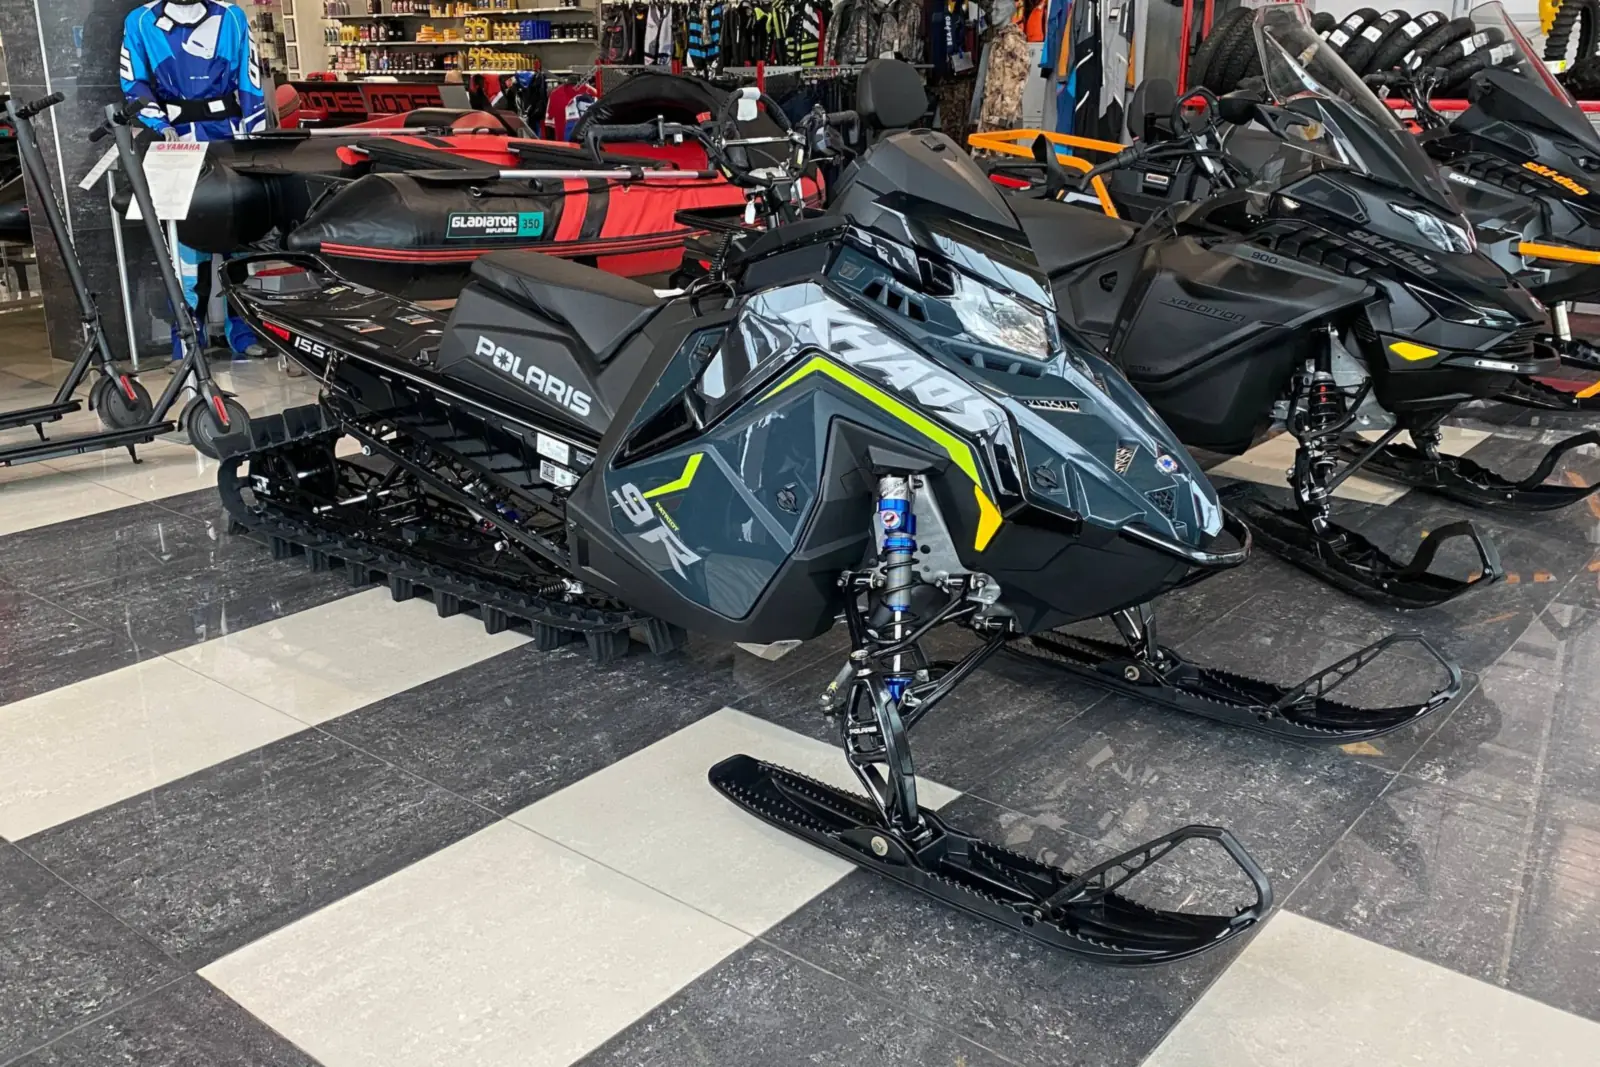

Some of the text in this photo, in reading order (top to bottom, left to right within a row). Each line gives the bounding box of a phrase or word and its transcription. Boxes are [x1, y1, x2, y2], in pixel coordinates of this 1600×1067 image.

[166, 143, 201, 151] YAMAHA
[523, 219, 540, 229] 350
[1251, 251, 1278, 265] 900
[294, 335, 326, 359] 155
[475, 335, 592, 417] POLARIS
[779, 299, 1006, 433] KHAOS
[655, 501, 680, 531] PATRIOT
